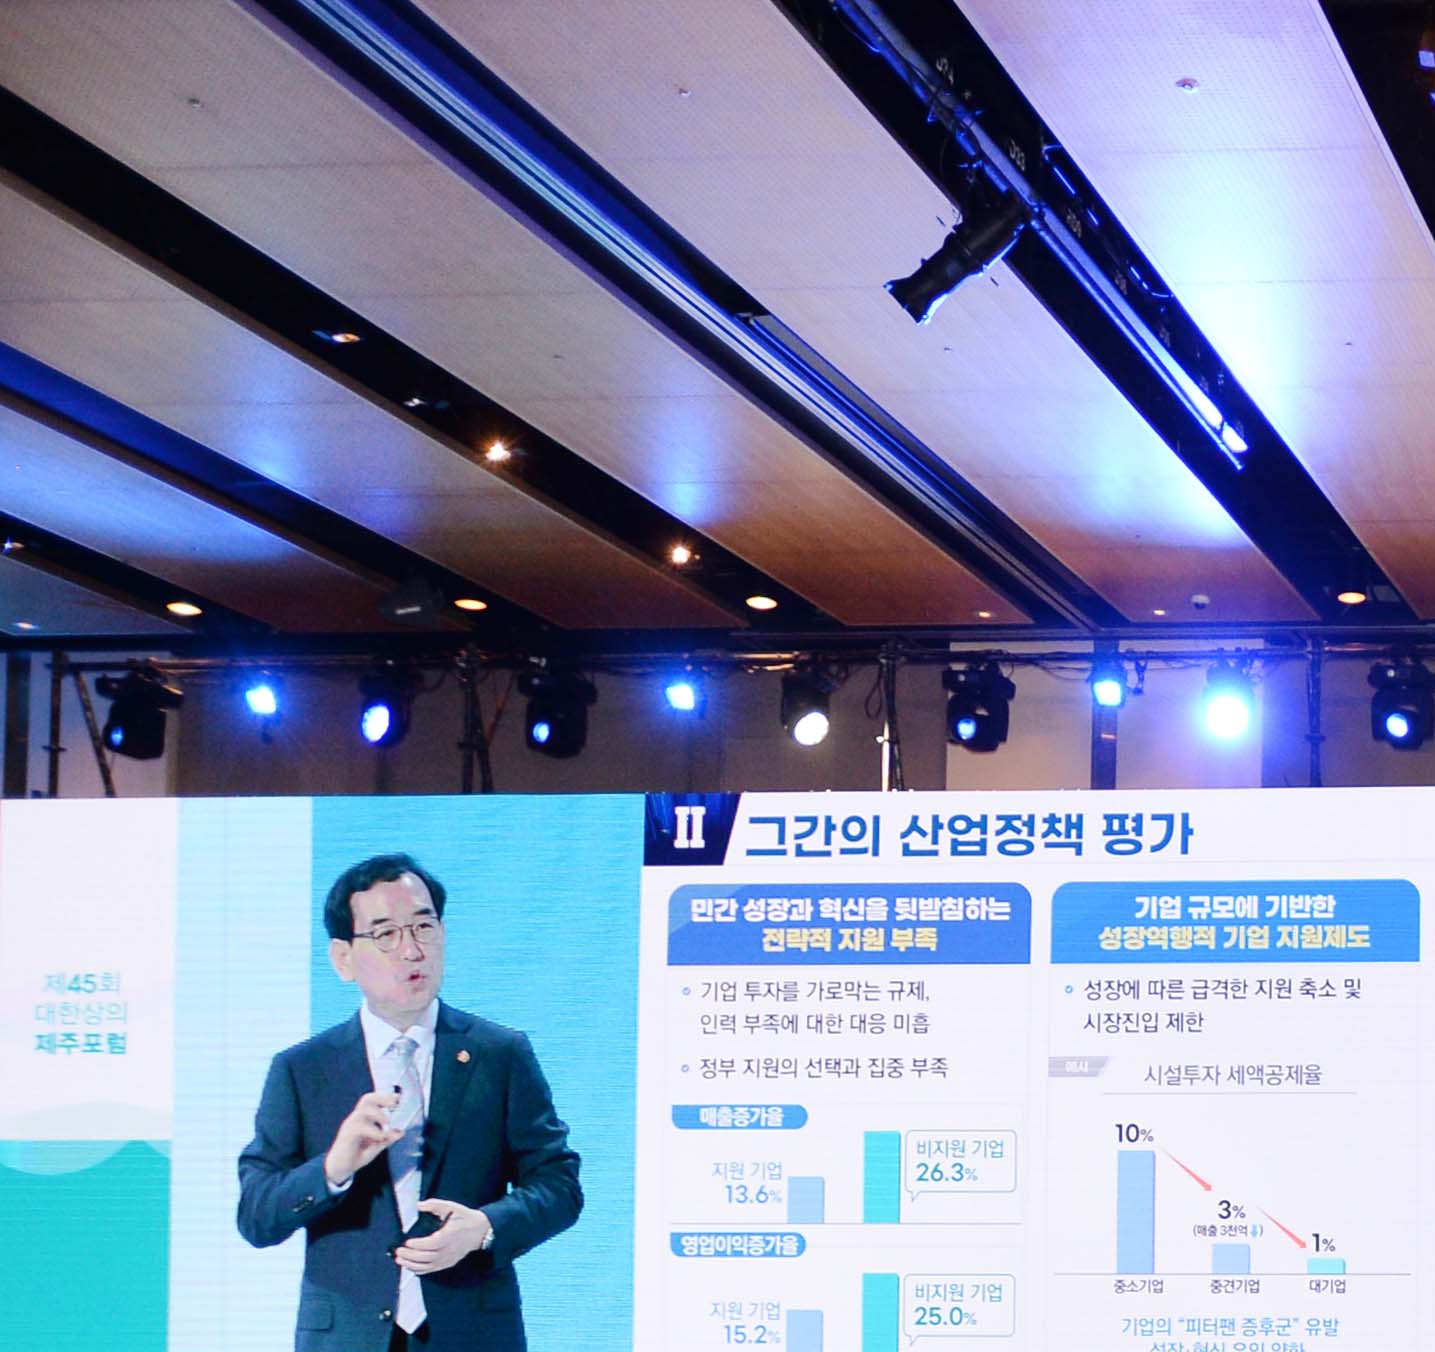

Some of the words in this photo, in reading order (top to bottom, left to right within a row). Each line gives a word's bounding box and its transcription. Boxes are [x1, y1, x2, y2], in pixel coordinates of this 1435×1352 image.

[745, 814, 881, 858] 그간의
[899, 812, 1084, 858] 산업정책
[1101, 811, 1195, 857] 평가
[689, 897, 740, 923] 민간
[741, 897, 815, 923] 성장과
[817, 896, 890, 923] 혁신을
[893, 895, 1012, 922] 뒷받침하는
[1134, 895, 1183, 921] 기업
[1187, 894, 1260, 921] 규모에
[1264, 894, 1337, 919] 기반한
[761, 927, 833, 953] 전략적
[837, 926, 887, 952] 지원
[889, 926, 939, 953] 부족
[1097, 925, 1217, 951] 성장역행적
[1222, 924, 1270, 950] 기업
[1275, 924, 1372, 950] 지원제도
[701, 981, 737, 1003] 기업
[743, 980, 801, 1003] 투자를
[806, 980, 882, 1003] 가로막는
[1083, 979, 1141, 1002] 성장에
[1147, 979, 1186, 1001] 따른
[1190, 978, 1249, 1001] 급격한
[1254, 977, 1292, 1001] 지원
[1298, 977, 1337, 1000] 축소
[1343, 977, 1361, 1000] 및
[700, 1013, 737, 1035] 인력
[743, 1013, 799, 1035] 부족에
[806, 1013, 845, 1035] 대한
[849, 1012, 887, 1035] 대응
[893, 1012, 931, 1035] 미흡
[1083, 1011, 1159, 1034] 시장진입
[1165, 1011, 1205, 1033] 제한
[699, 1058, 737, 1080] 정부
[742, 1057, 798, 1079] 지원의
[804, 1057, 862, 1079] 선택과
[867, 1057, 905, 1079] 집중
[909, 1057, 949, 1079] 부족
[1143, 1064, 1222, 1087] 시설투자
[1226, 1063, 1323, 1087] 세액공제율
[698, 1106, 785, 1128] 매출증가율
[1114, 1123, 1154, 1144] 10%
[916, 1138, 967, 1160] 비지원
[971, 1139, 1005, 1159] 기업
[711, 1161, 745, 1181] 지원
[751, 1161, 783, 1181] 기업
[915, 1161, 978, 1183] 26.3%
[724, 1183, 783, 1205] 13.6%
[1217, 1199, 1247, 1220] 3%
[680, 1234, 800, 1256] 영업이익증가율
[1311, 1232, 1336, 1253] 1%
[914, 1282, 965, 1303] 비지원
[970, 1283, 1003, 1303] 기업
[1113, 1279, 1164, 1295] 중소기업
[1209, 1279, 1261, 1295] 중견기업
[1308, 1279, 1347, 1295] 대기업
[709, 1301, 743, 1321] 지원
[748, 1301, 781, 1321] 기업
[914, 1305, 977, 1327] 25.0%
[723, 1323, 781, 1345] 15.2%
[1121, 1317, 1172, 1337] 기업의
[1304, 1317, 1341, 1338] 유발
